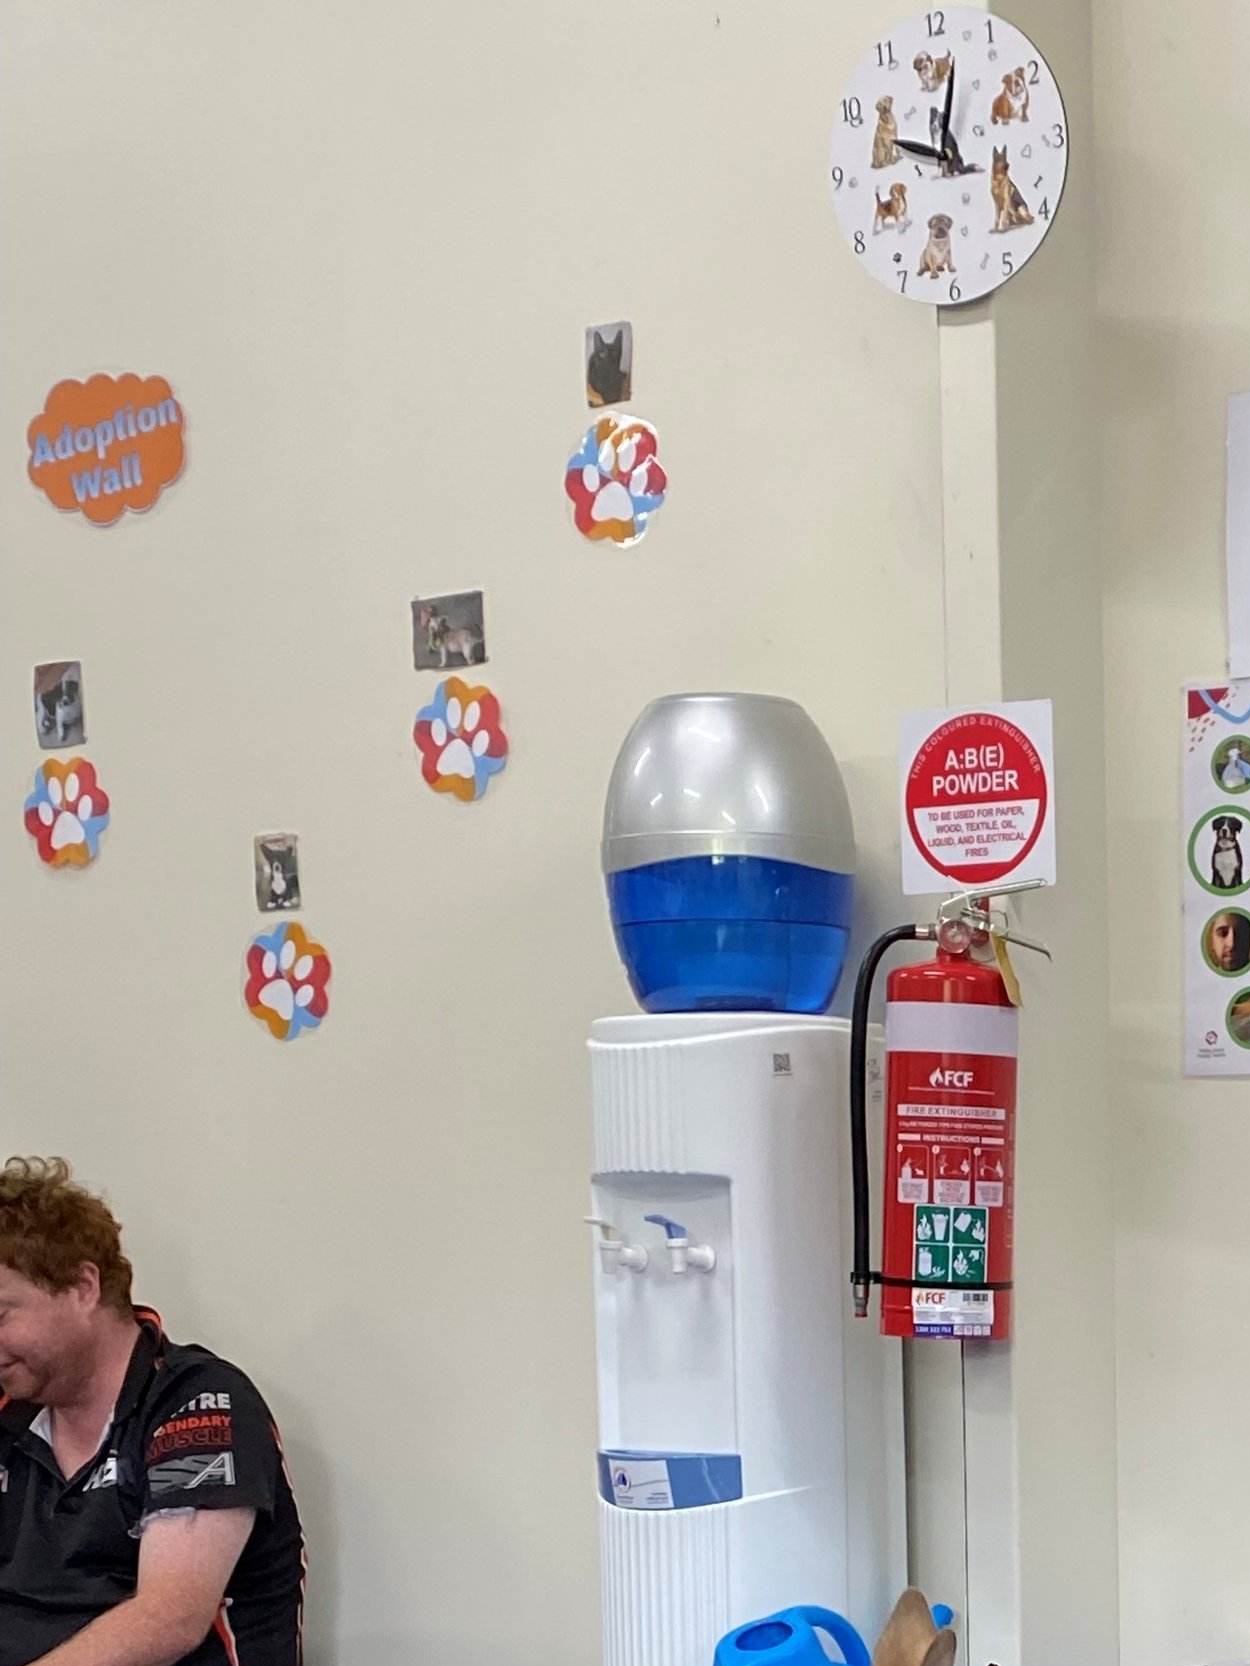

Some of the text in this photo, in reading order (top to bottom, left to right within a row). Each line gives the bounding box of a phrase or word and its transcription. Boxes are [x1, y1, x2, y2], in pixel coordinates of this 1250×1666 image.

[925, 11, 945, 37] 12
[985, 19, 994, 43] 1
[874, 40, 894, 67] 11
[1027, 60, 1040, 85] 2
[840, 97, 861, 123] 10
[1053, 123, 1064, 149] 3
[832, 167, 844, 190] 9
[1038, 196, 1050, 221] 4
[854, 230, 866, 254] 8
[1002, 252, 1013, 276] 5
[897, 270, 908, 293] 7
[950, 277, 961, 301] 6
[32, 397, 178, 468] Adoption
[71, 453, 143, 503] Wall
[911, 754, 926, 779] THIS
[945, 742, 1005, 771] A:B(E)
[932, 769, 1019, 797] POWDER
[928, 812, 939, 822] TO
[941, 811, 952, 821] BE
[953, 809, 975, 820] USED
[977, 808, 994, 818] FOR
[957, 835, 975, 845] AND
[944, 1070, 974, 1087] FCF
[906, 1106, 998, 1118] FIRE EXTINGUISHER
[925, 1292, 946, 1305] FCF
